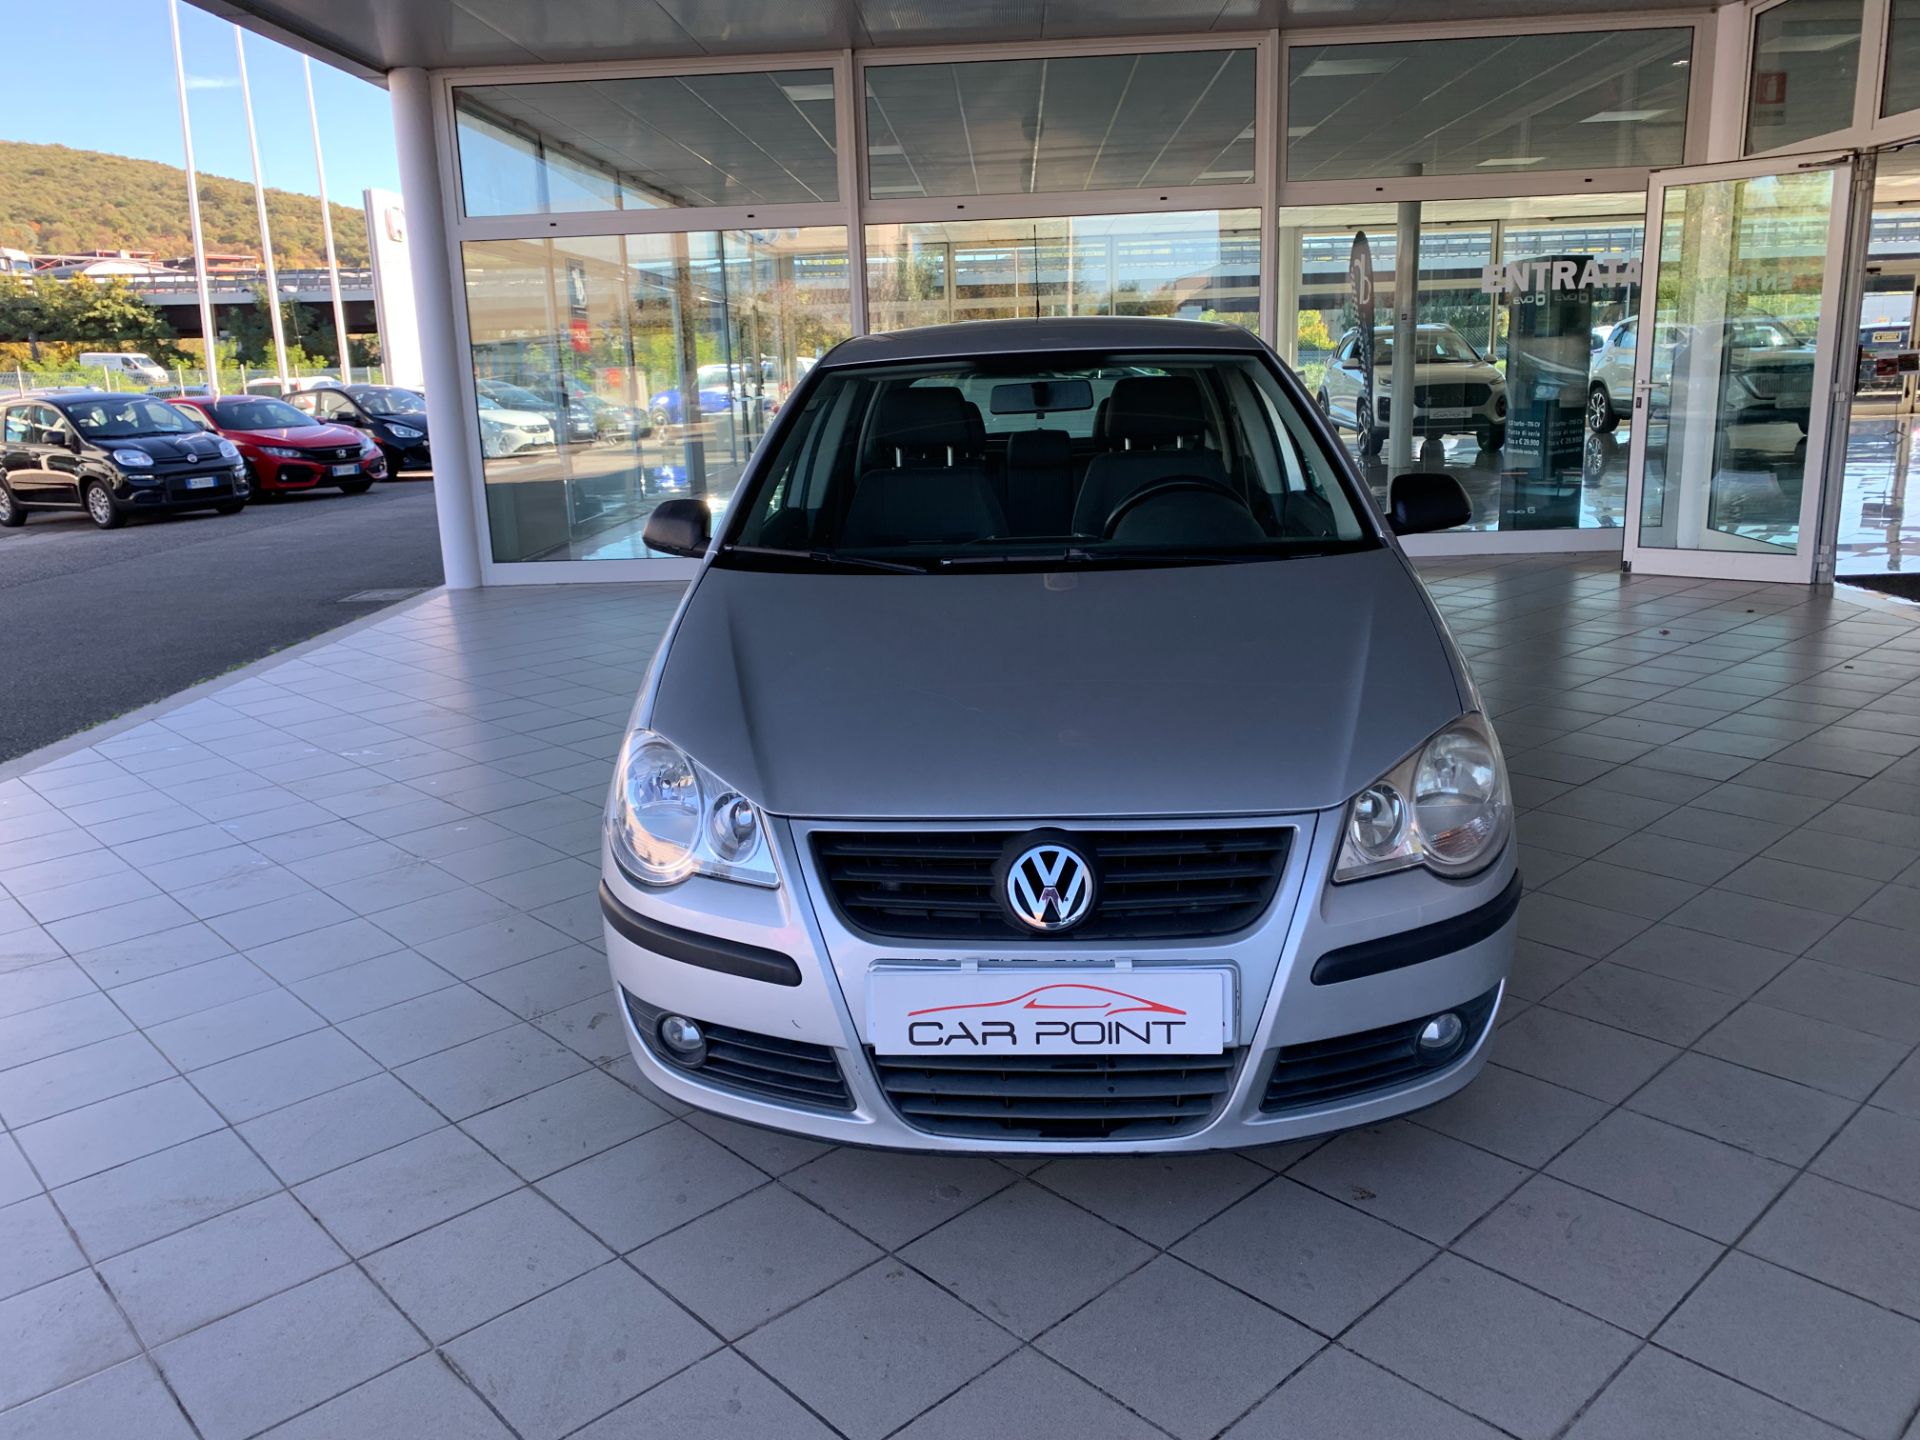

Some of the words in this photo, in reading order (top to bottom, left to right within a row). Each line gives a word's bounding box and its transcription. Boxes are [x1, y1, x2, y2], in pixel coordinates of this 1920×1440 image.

[1481, 257, 1641, 293] ENTRATA
[908, 1021, 1017, 1046] CAR
[1035, 1021, 1186, 1045] POINT
